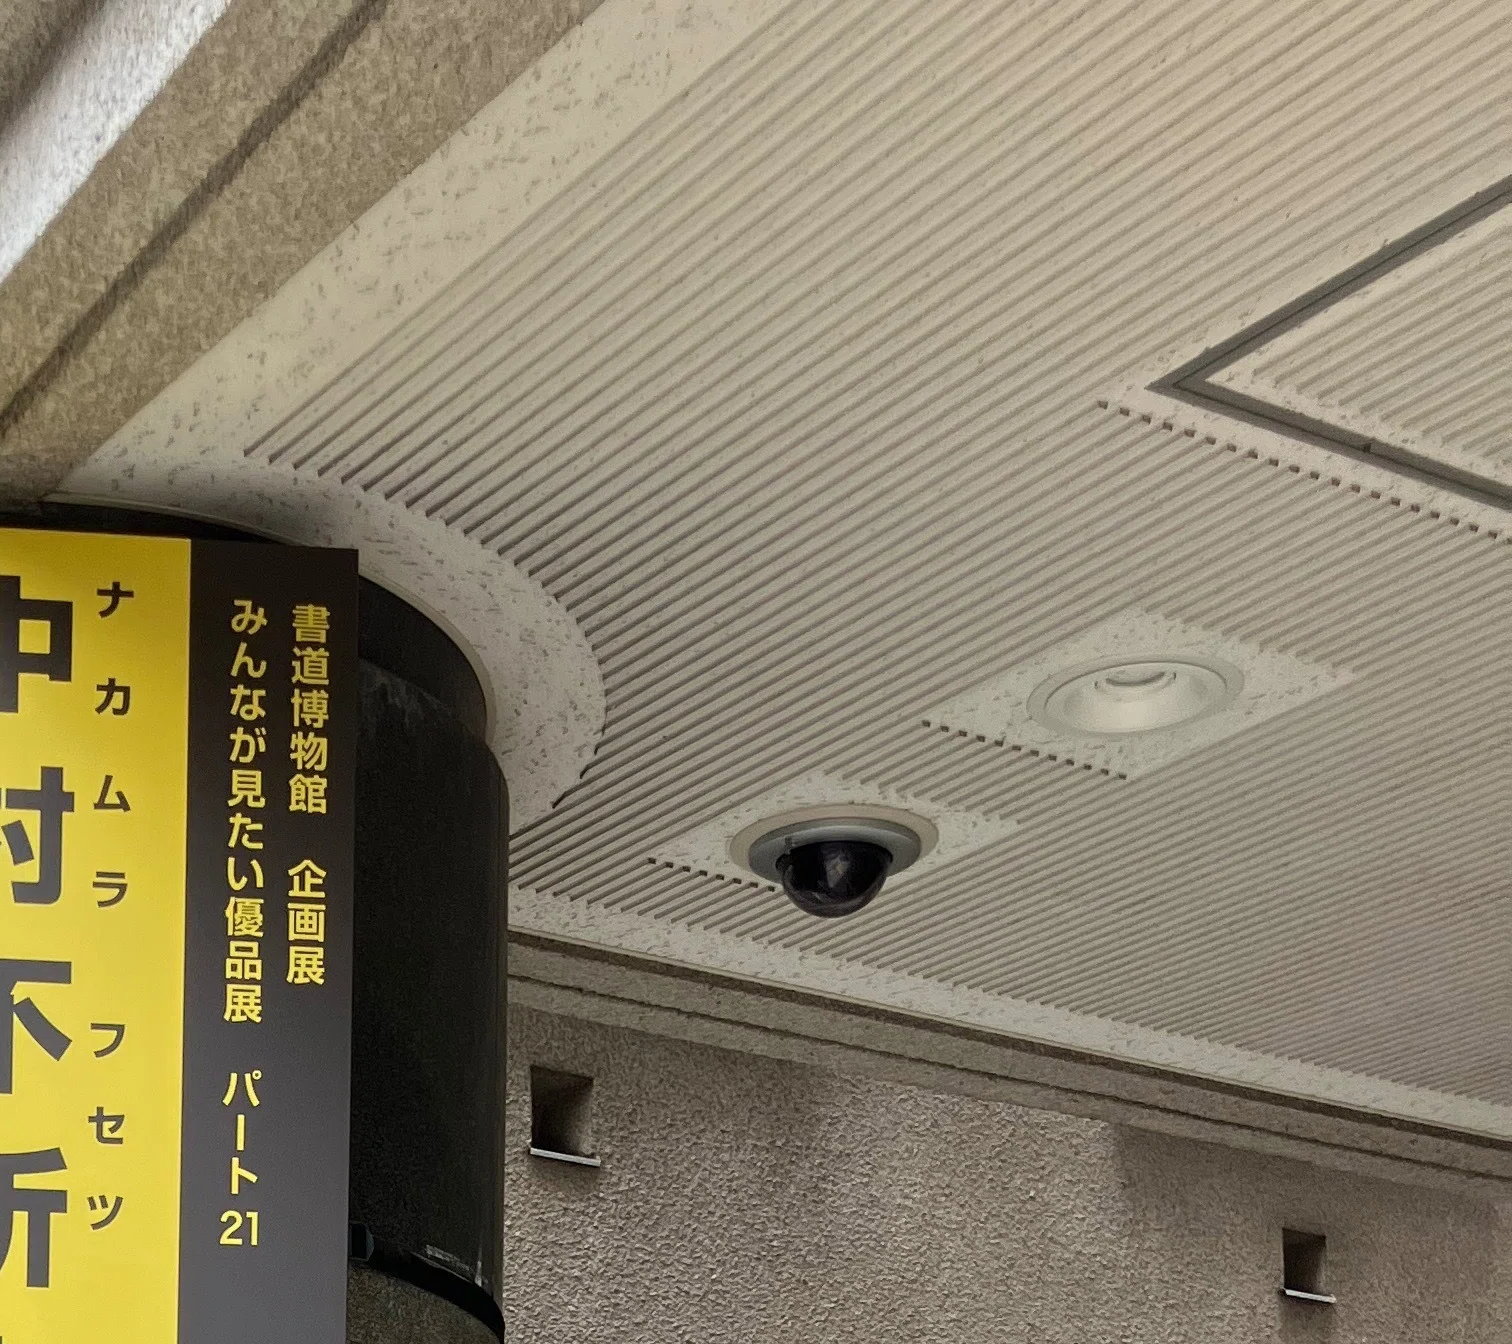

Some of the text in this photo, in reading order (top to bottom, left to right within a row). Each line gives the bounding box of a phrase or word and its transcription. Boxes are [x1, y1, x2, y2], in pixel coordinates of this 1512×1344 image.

[87, 580, 136, 1232] ナカムラ フセツ
[222, 598, 269, 1024] みんなが見たい優品展
[285, 604, 331, 986] 書道博物館 企画展
